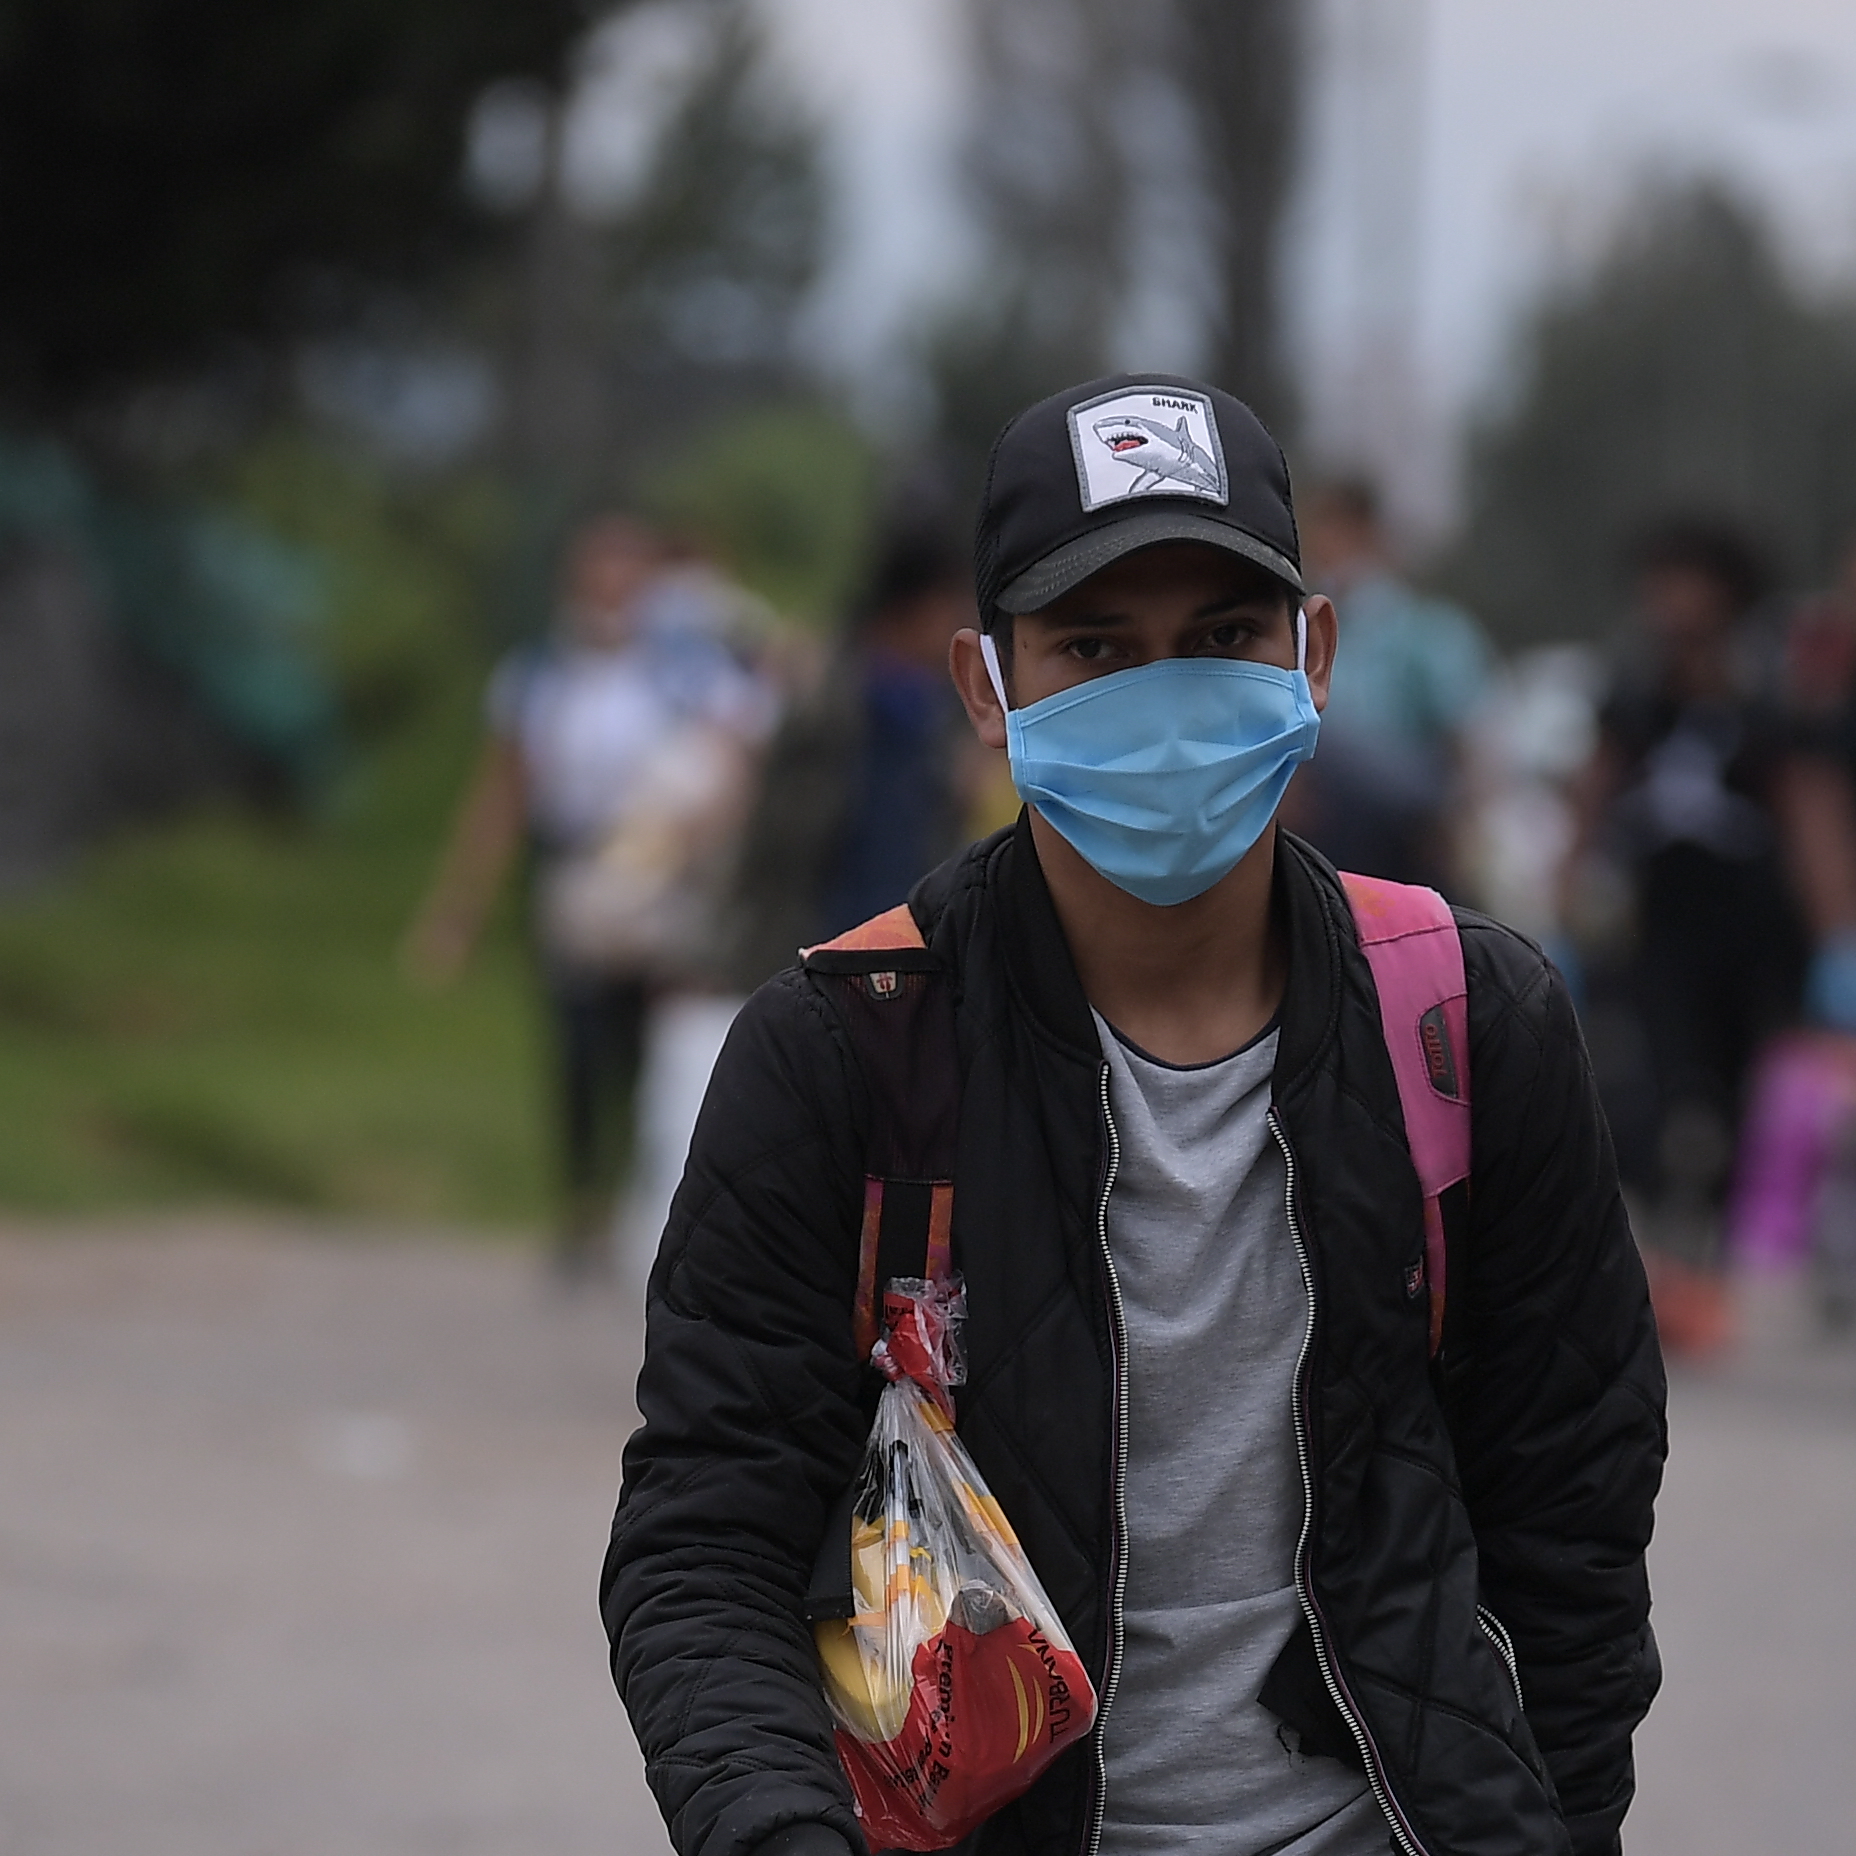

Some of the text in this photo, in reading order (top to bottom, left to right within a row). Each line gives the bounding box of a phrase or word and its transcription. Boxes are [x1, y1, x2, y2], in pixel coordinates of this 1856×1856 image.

[1152, 397, 1198, 414] SHARK
[1425, 1024, 1448, 1078] TOTTO
[936, 1639, 955, 1758] Premi
[1027, 1629, 1070, 1744] TURBANA
